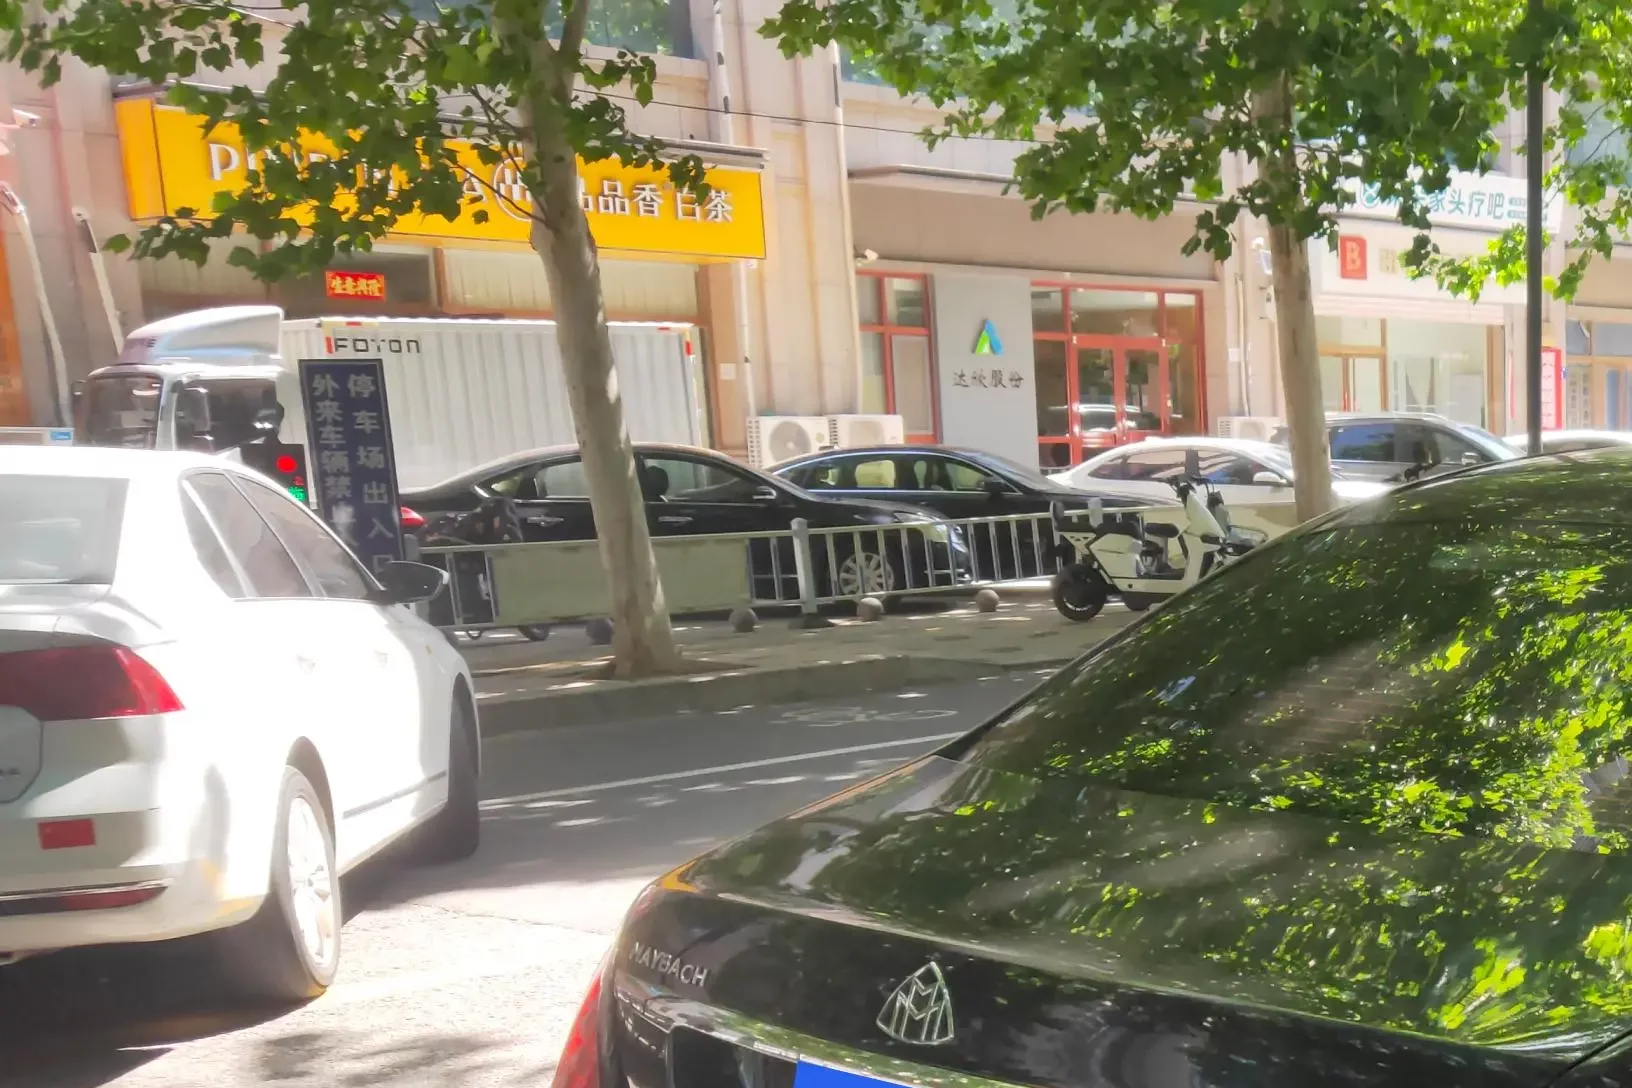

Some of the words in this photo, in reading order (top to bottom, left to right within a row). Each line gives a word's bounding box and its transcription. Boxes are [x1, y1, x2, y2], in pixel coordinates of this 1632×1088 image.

[347, 373, 396, 576] 停车场出入口
[628, 941, 708, 988] MAYBACH
